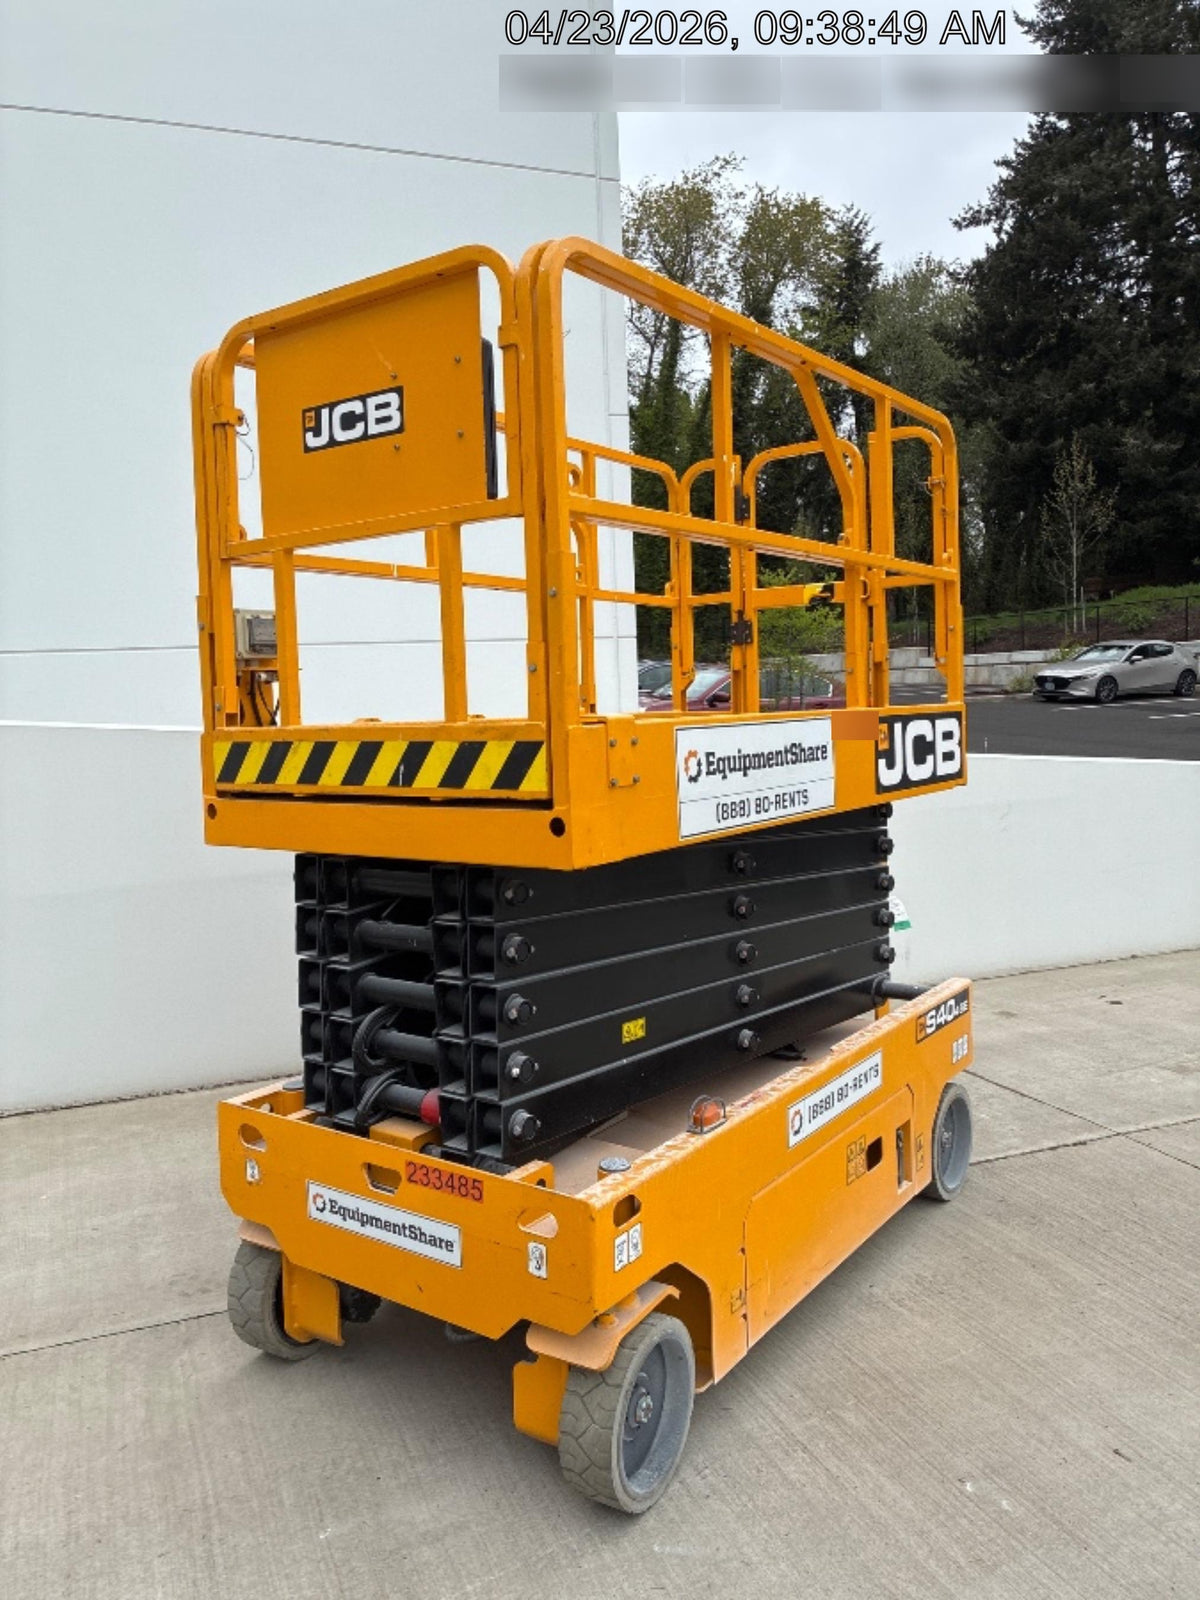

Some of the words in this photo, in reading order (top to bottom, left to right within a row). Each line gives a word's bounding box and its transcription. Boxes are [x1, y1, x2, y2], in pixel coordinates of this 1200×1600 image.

[305, 392, 401, 448] JCB
[705, 742, 828, 780] EquipmentShare
[877, 717, 961, 787] JCB
[716, 797, 751, 824] (888)
[406, 1160, 484, 1202] 233485
[328, 1199, 455, 1253] EquipmentShare
